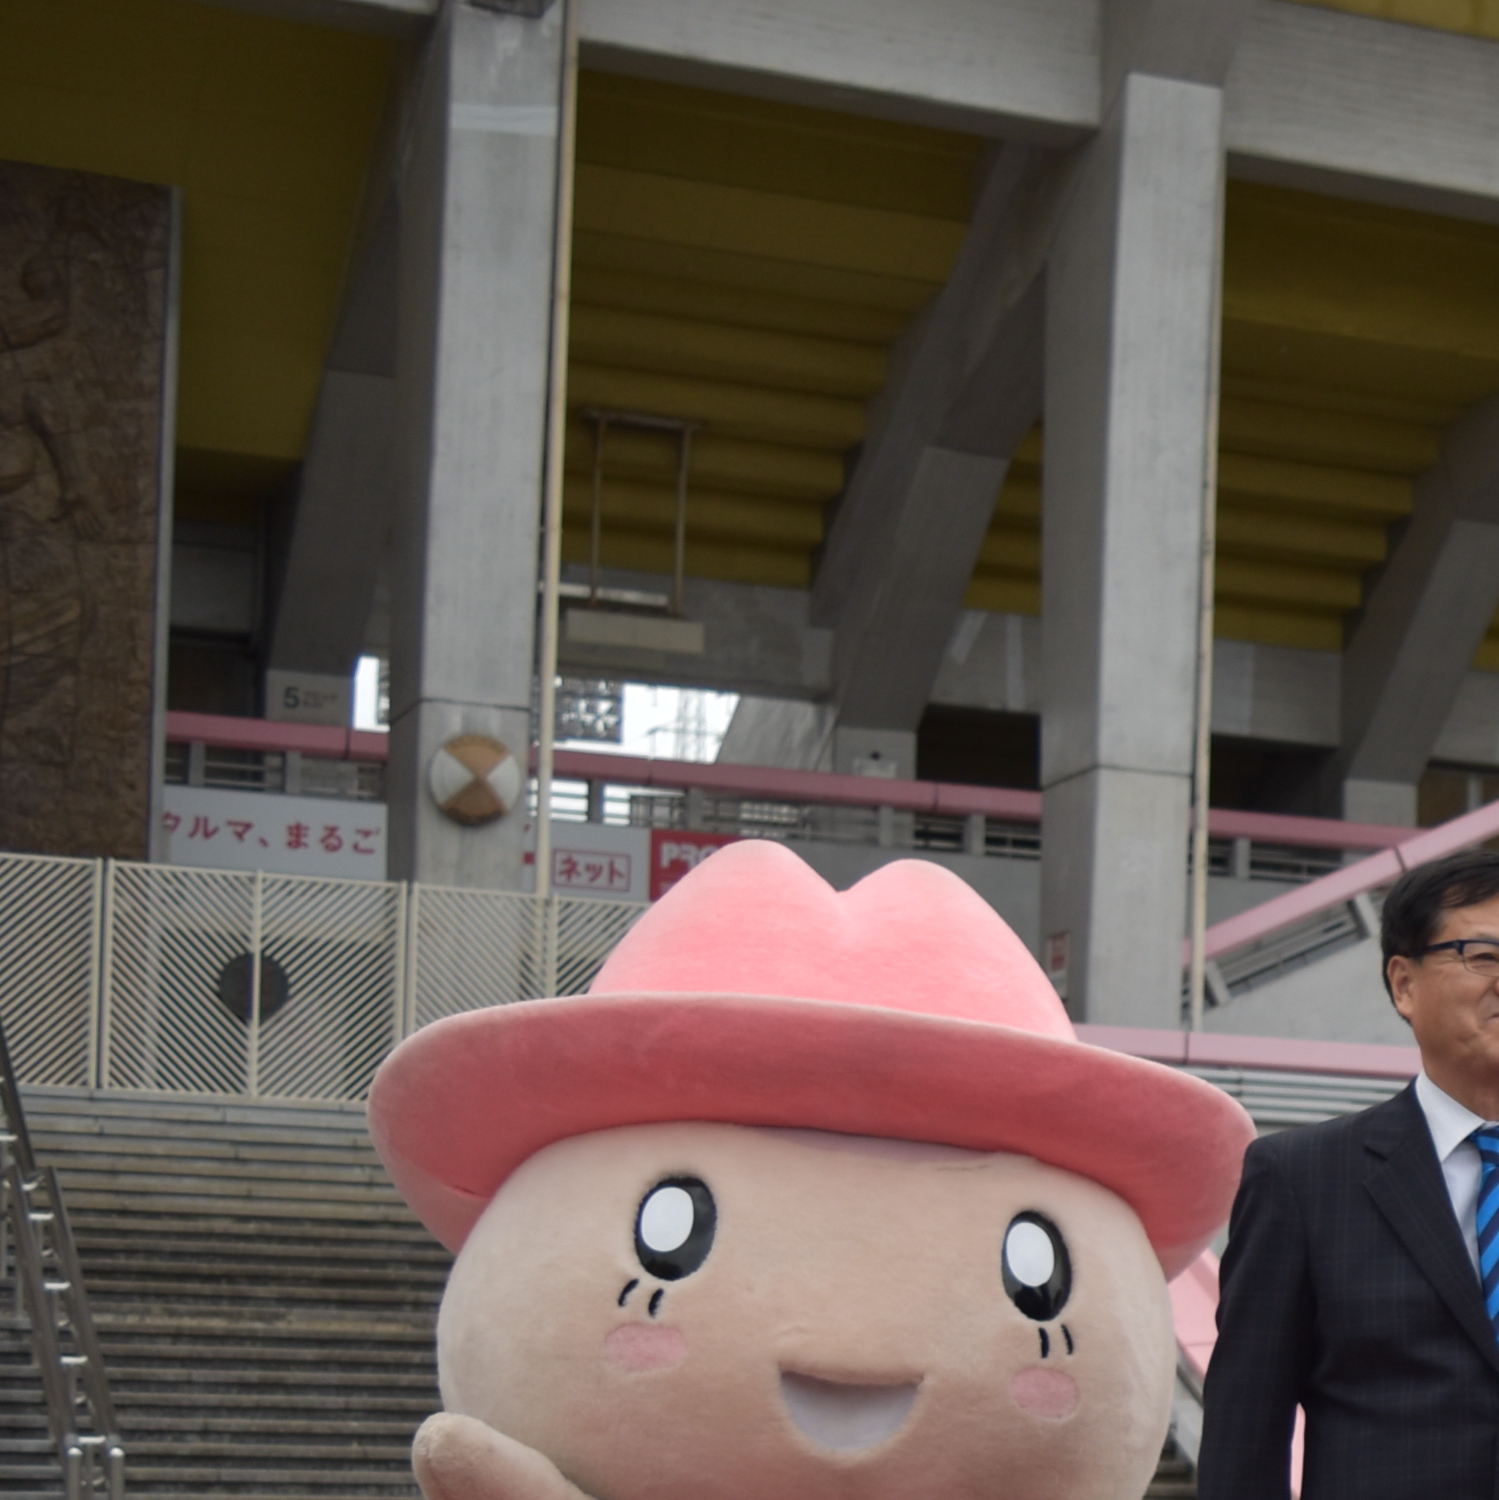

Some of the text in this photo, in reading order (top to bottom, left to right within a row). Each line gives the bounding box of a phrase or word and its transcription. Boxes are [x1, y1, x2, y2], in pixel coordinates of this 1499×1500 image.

[283, 686, 300, 709] 5
[660, 841, 724, 869] PR
[558, 854, 625, 887] ネット
